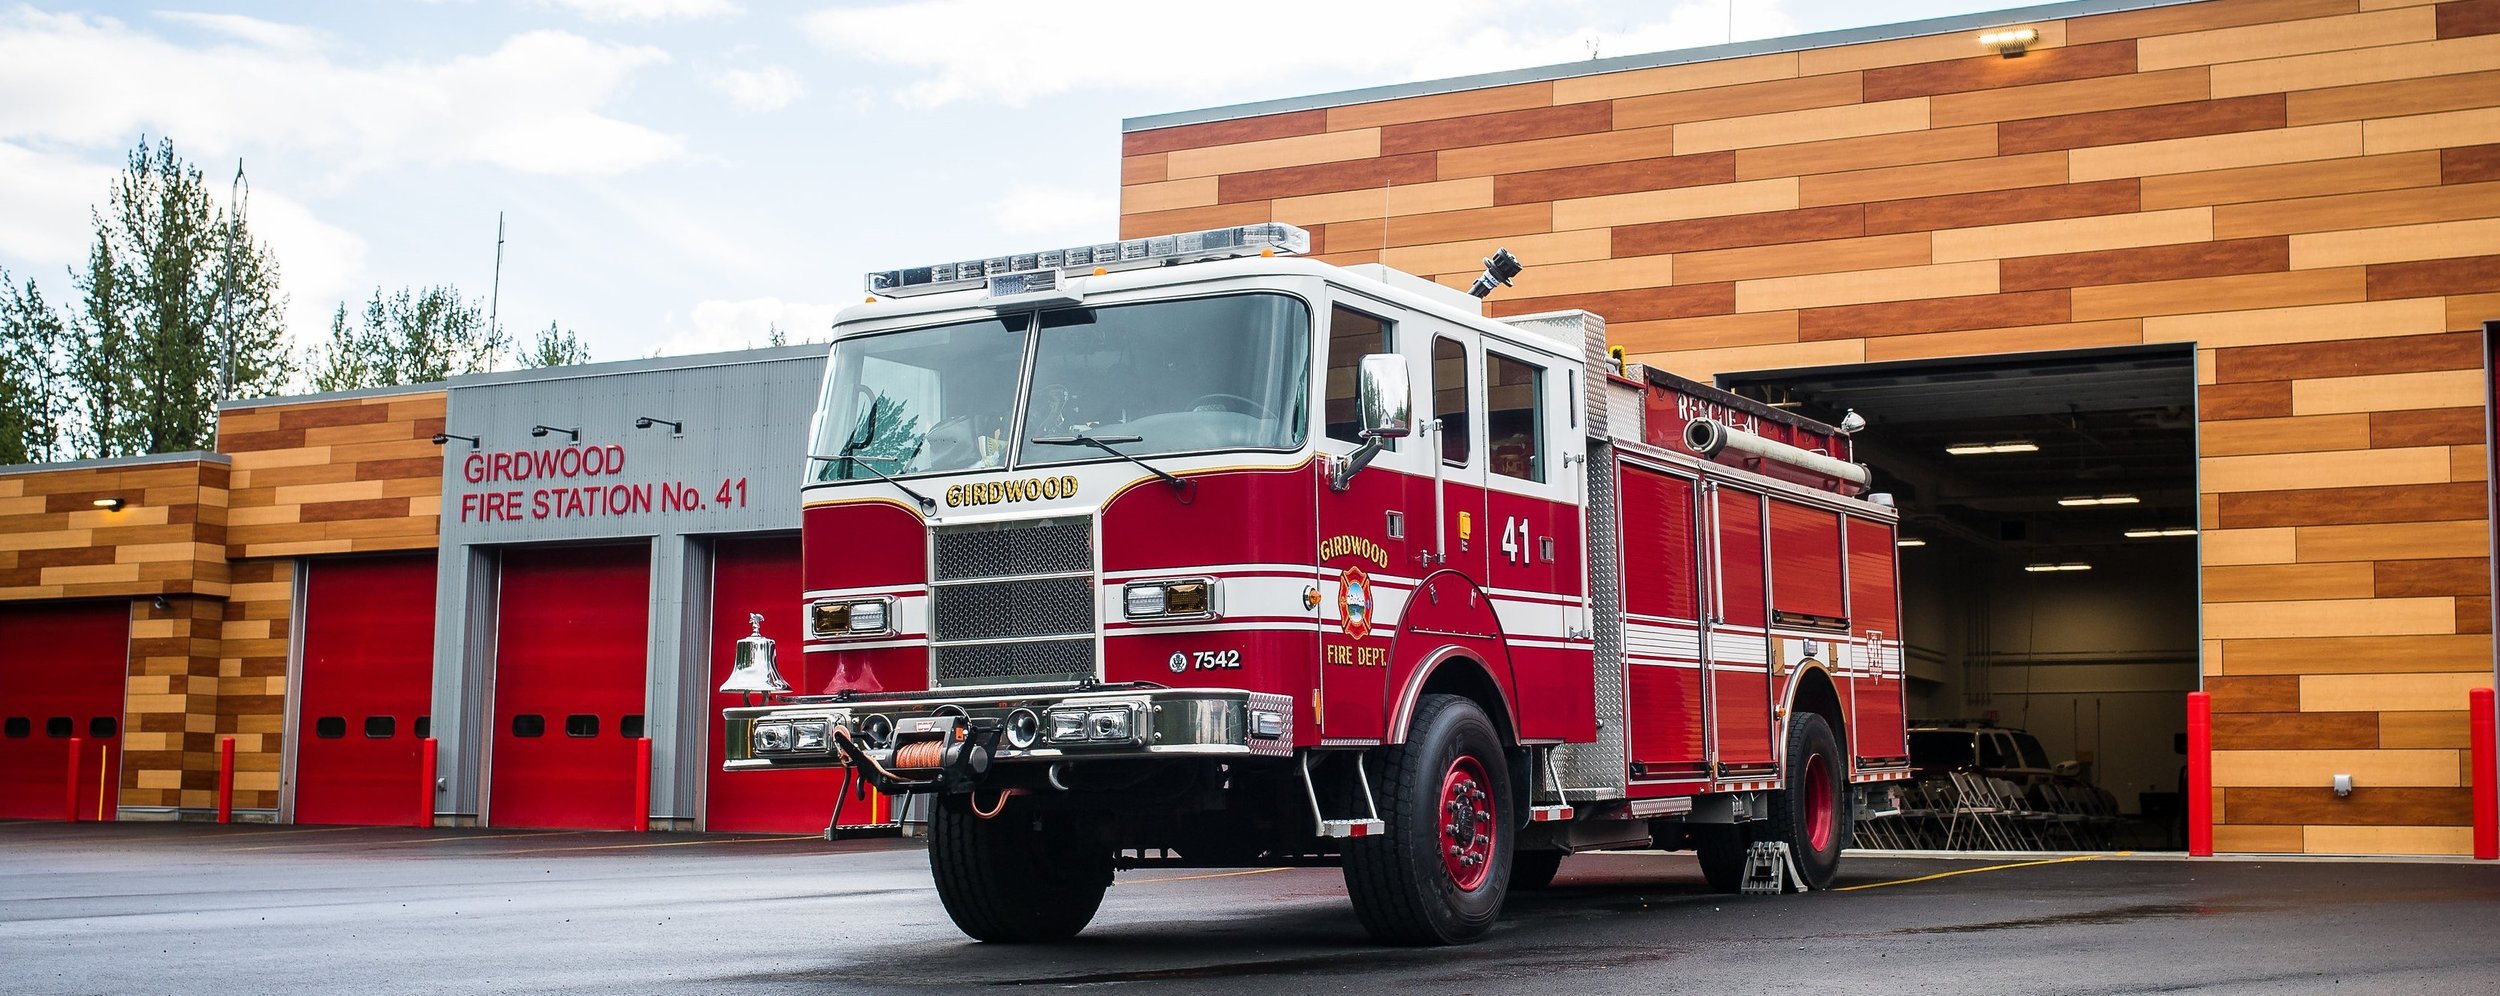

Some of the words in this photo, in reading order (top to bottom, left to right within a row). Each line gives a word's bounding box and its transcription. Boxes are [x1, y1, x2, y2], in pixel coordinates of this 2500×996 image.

[1678, 392, 1736, 428] RESCUE
[464, 445, 624, 483] GIRDWOOD
[461, 491, 524, 523] FIRE
[531, 483, 652, 519] STATION
[661, 481, 706, 513] No.
[715, 477, 746, 509] 41
[946, 475, 1079, 508] GIRDWOOD
[1320, 535, 1388, 569] GIRDWOOD
[1502, 515, 1530, 566] 41
[1193, 649, 1241, 671] 7542
[1327, 644, 1353, 665] FIRE
[1358, 646, 1387, 667] DEPT.
